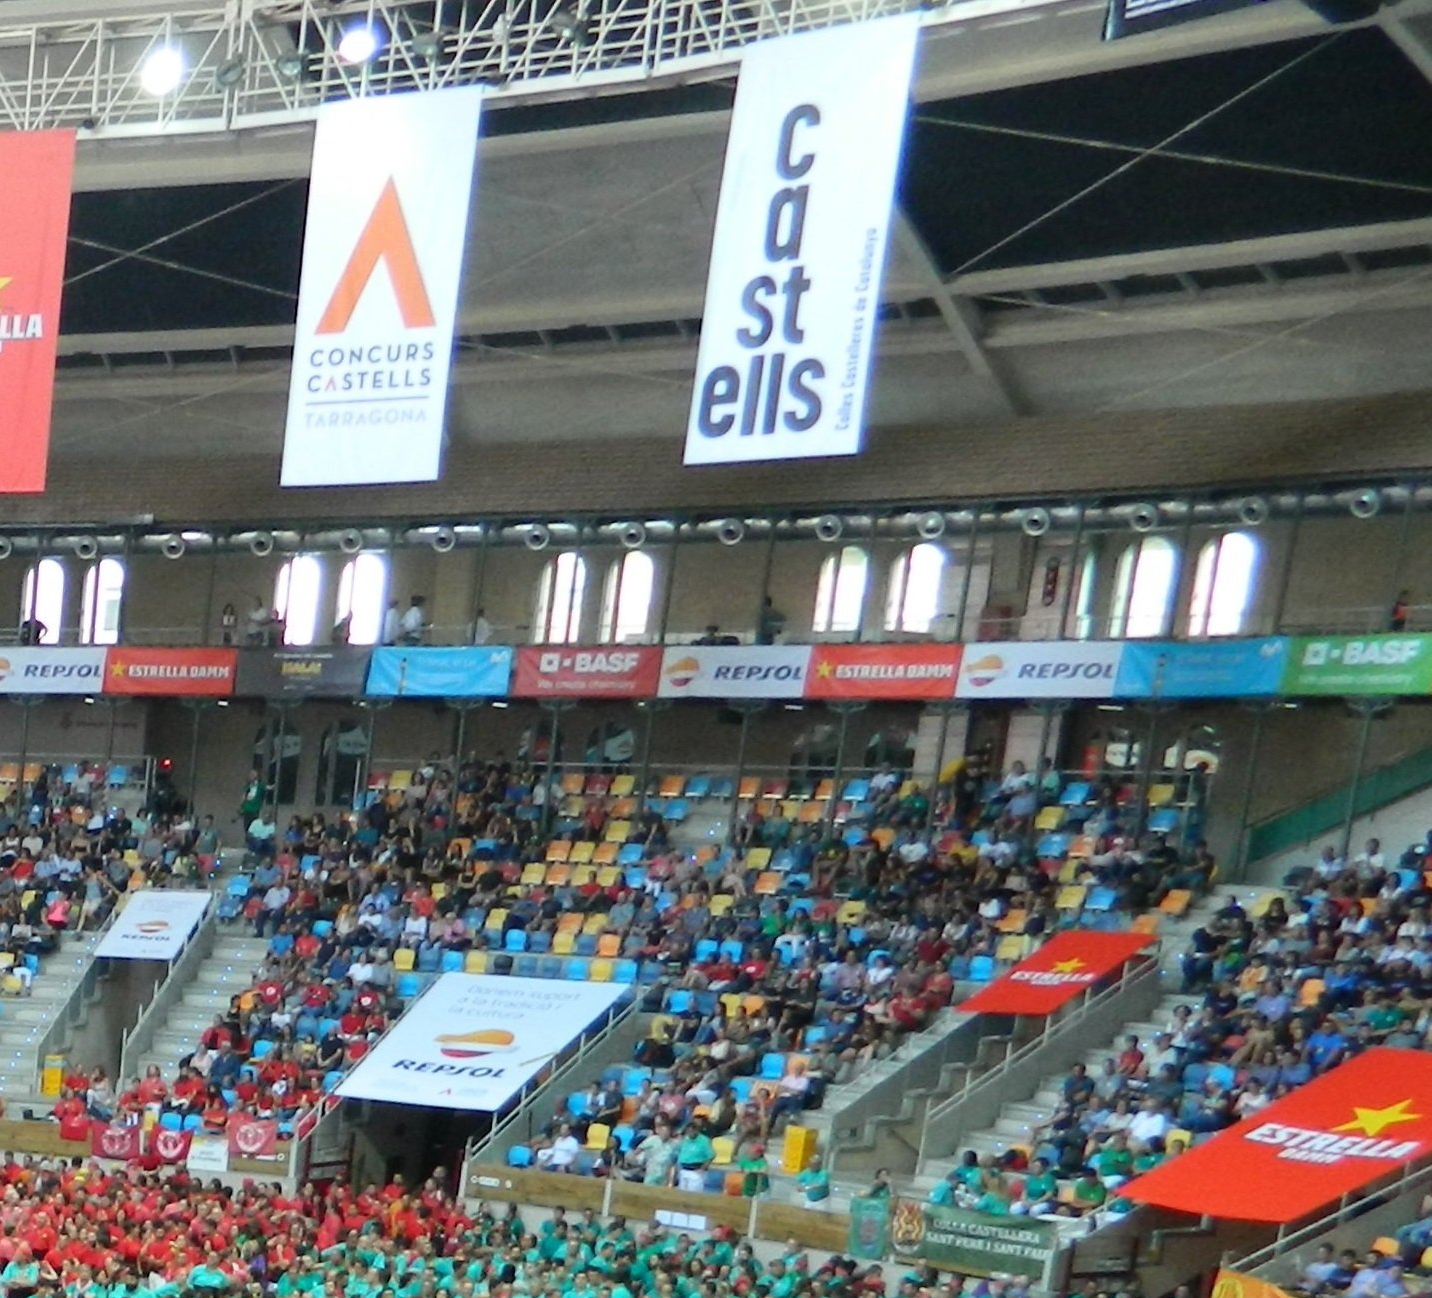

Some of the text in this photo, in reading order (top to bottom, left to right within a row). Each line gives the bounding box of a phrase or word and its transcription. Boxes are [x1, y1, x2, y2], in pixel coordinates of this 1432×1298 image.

[776, 103, 822, 180] c
[765, 184, 810, 261] a
[736, 265, 811, 349] st
[309, 341, 435, 368] CONCURS
[306, 367, 432, 393] CASTELLS
[697, 352, 827, 438] ells
[304, 407, 428, 430] TARRAGONA
[575, 653, 637, 674] BASF
[1342, 640, 1421, 667] BASF
[24, 664, 101, 679] REPSOL
[128, 665, 229, 680] ESTRELLA DAMM
[714, 665, 802, 682] REPSOL
[836, 663, 953, 678] ESTRELLA DAMM
[1017, 662, 1114, 680] REPSOL
[392, 1059, 505, 1078] REPSOL
[1244, 1123, 1421, 1159] ESTRELLA
[1277, 1148, 1341, 1164] DAMM
